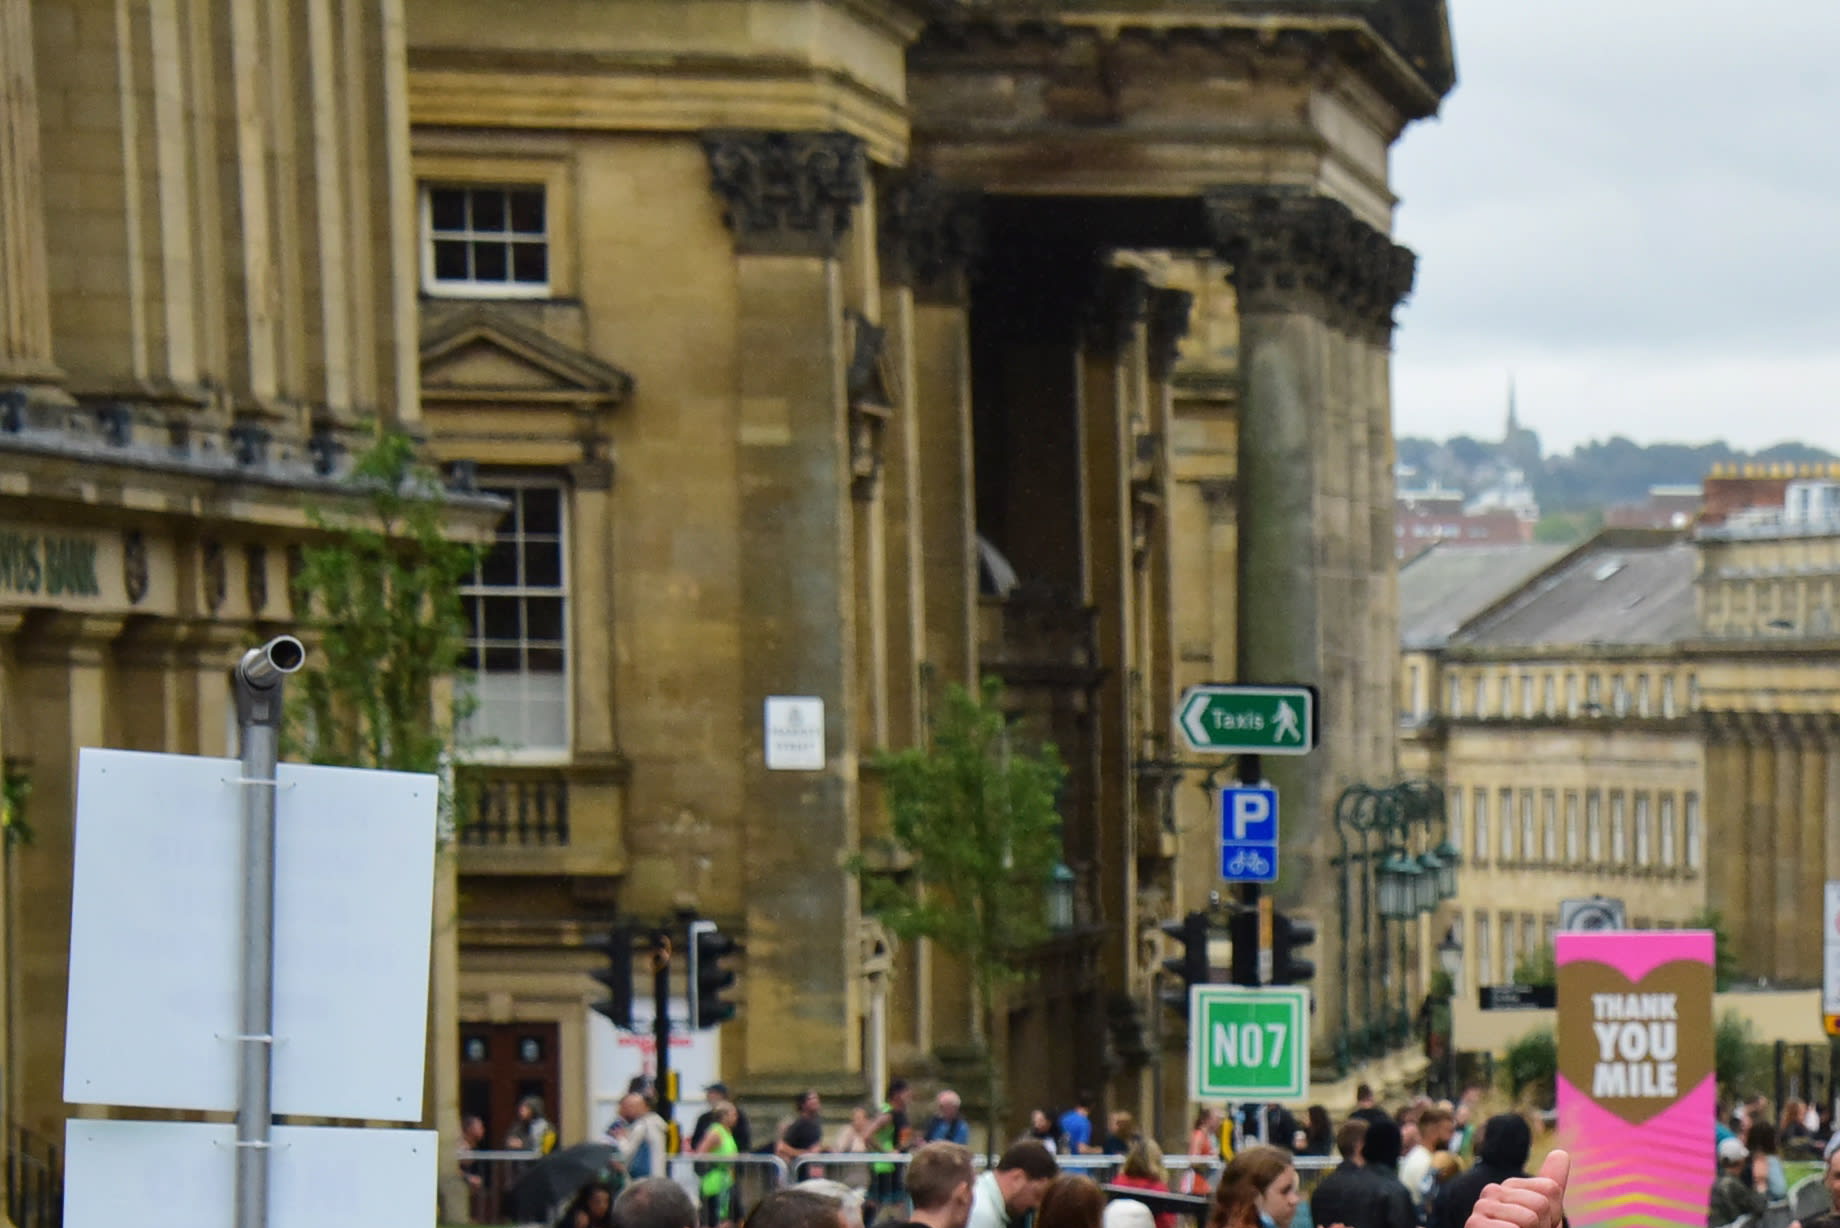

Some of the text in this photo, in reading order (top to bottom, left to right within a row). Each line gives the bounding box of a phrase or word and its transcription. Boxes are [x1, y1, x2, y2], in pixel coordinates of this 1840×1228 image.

[1211, 708, 1265, 730] Taxis
[1233, 793, 1270, 839] P
[1591, 992, 1678, 1020] THANK
[1592, 1021, 1678, 1061] YOU
[1592, 1061, 1678, 1098] MILE
